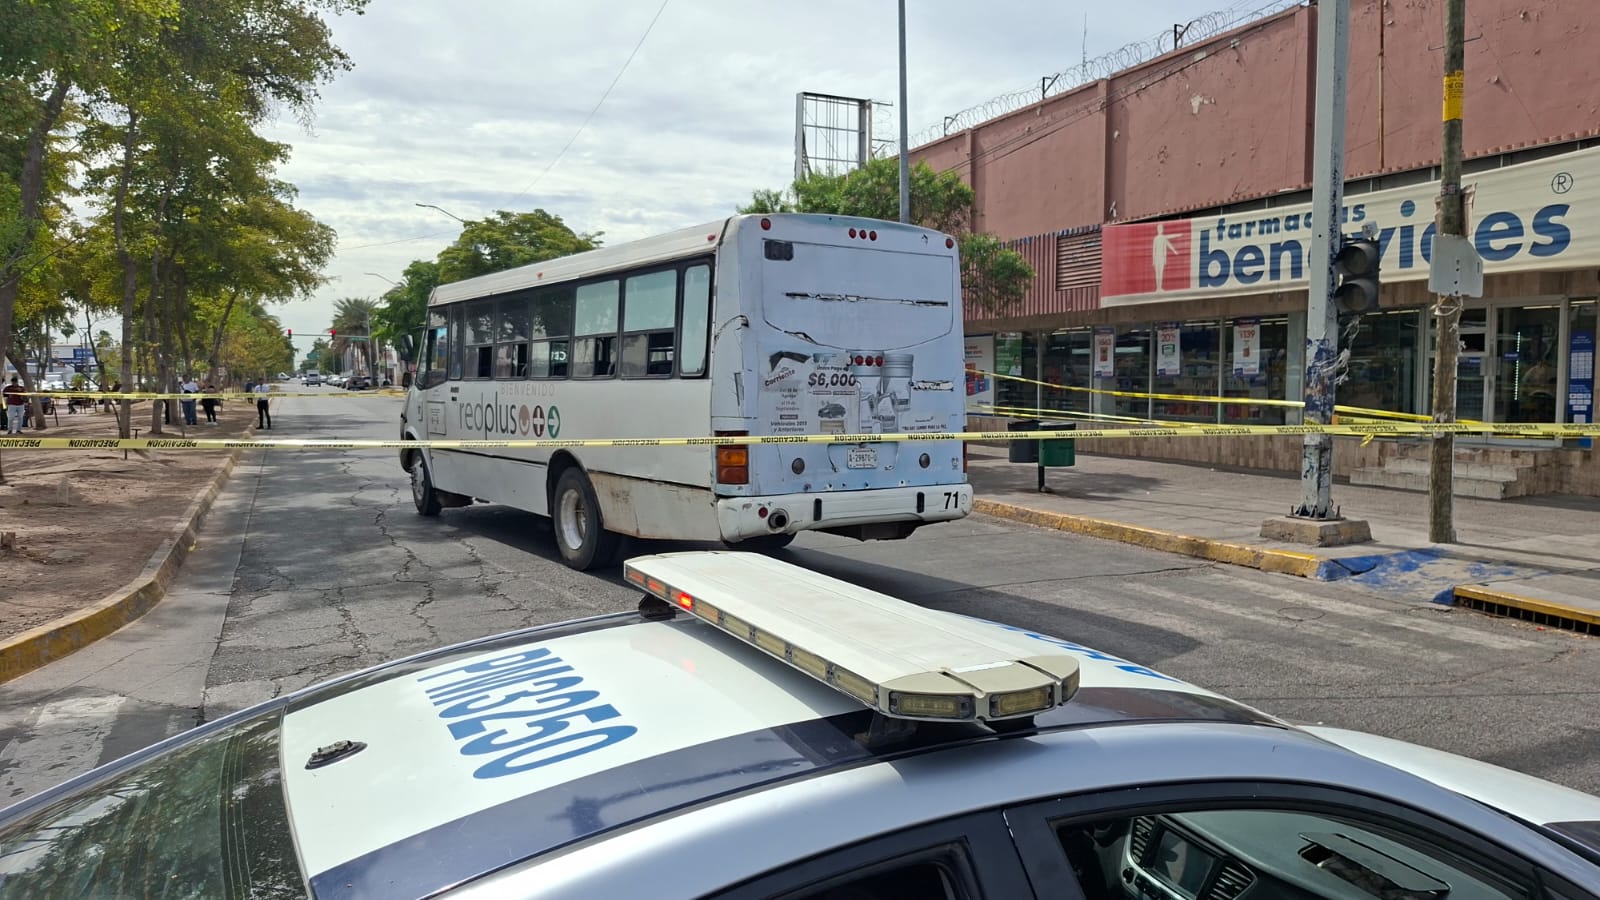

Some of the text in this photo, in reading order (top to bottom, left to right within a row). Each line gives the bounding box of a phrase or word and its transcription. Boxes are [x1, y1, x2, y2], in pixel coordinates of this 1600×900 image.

[1217, 203, 1366, 241] farmacs
[501, 383, 555, 396] BIENVENIDO
[808, 372, 857, 388] $6,000
[459, 391, 517, 440] redplus
[68, 440, 120, 448] PRECAUCION
[944, 491, 959, 510] 71
[417, 648, 638, 779] PM3250
